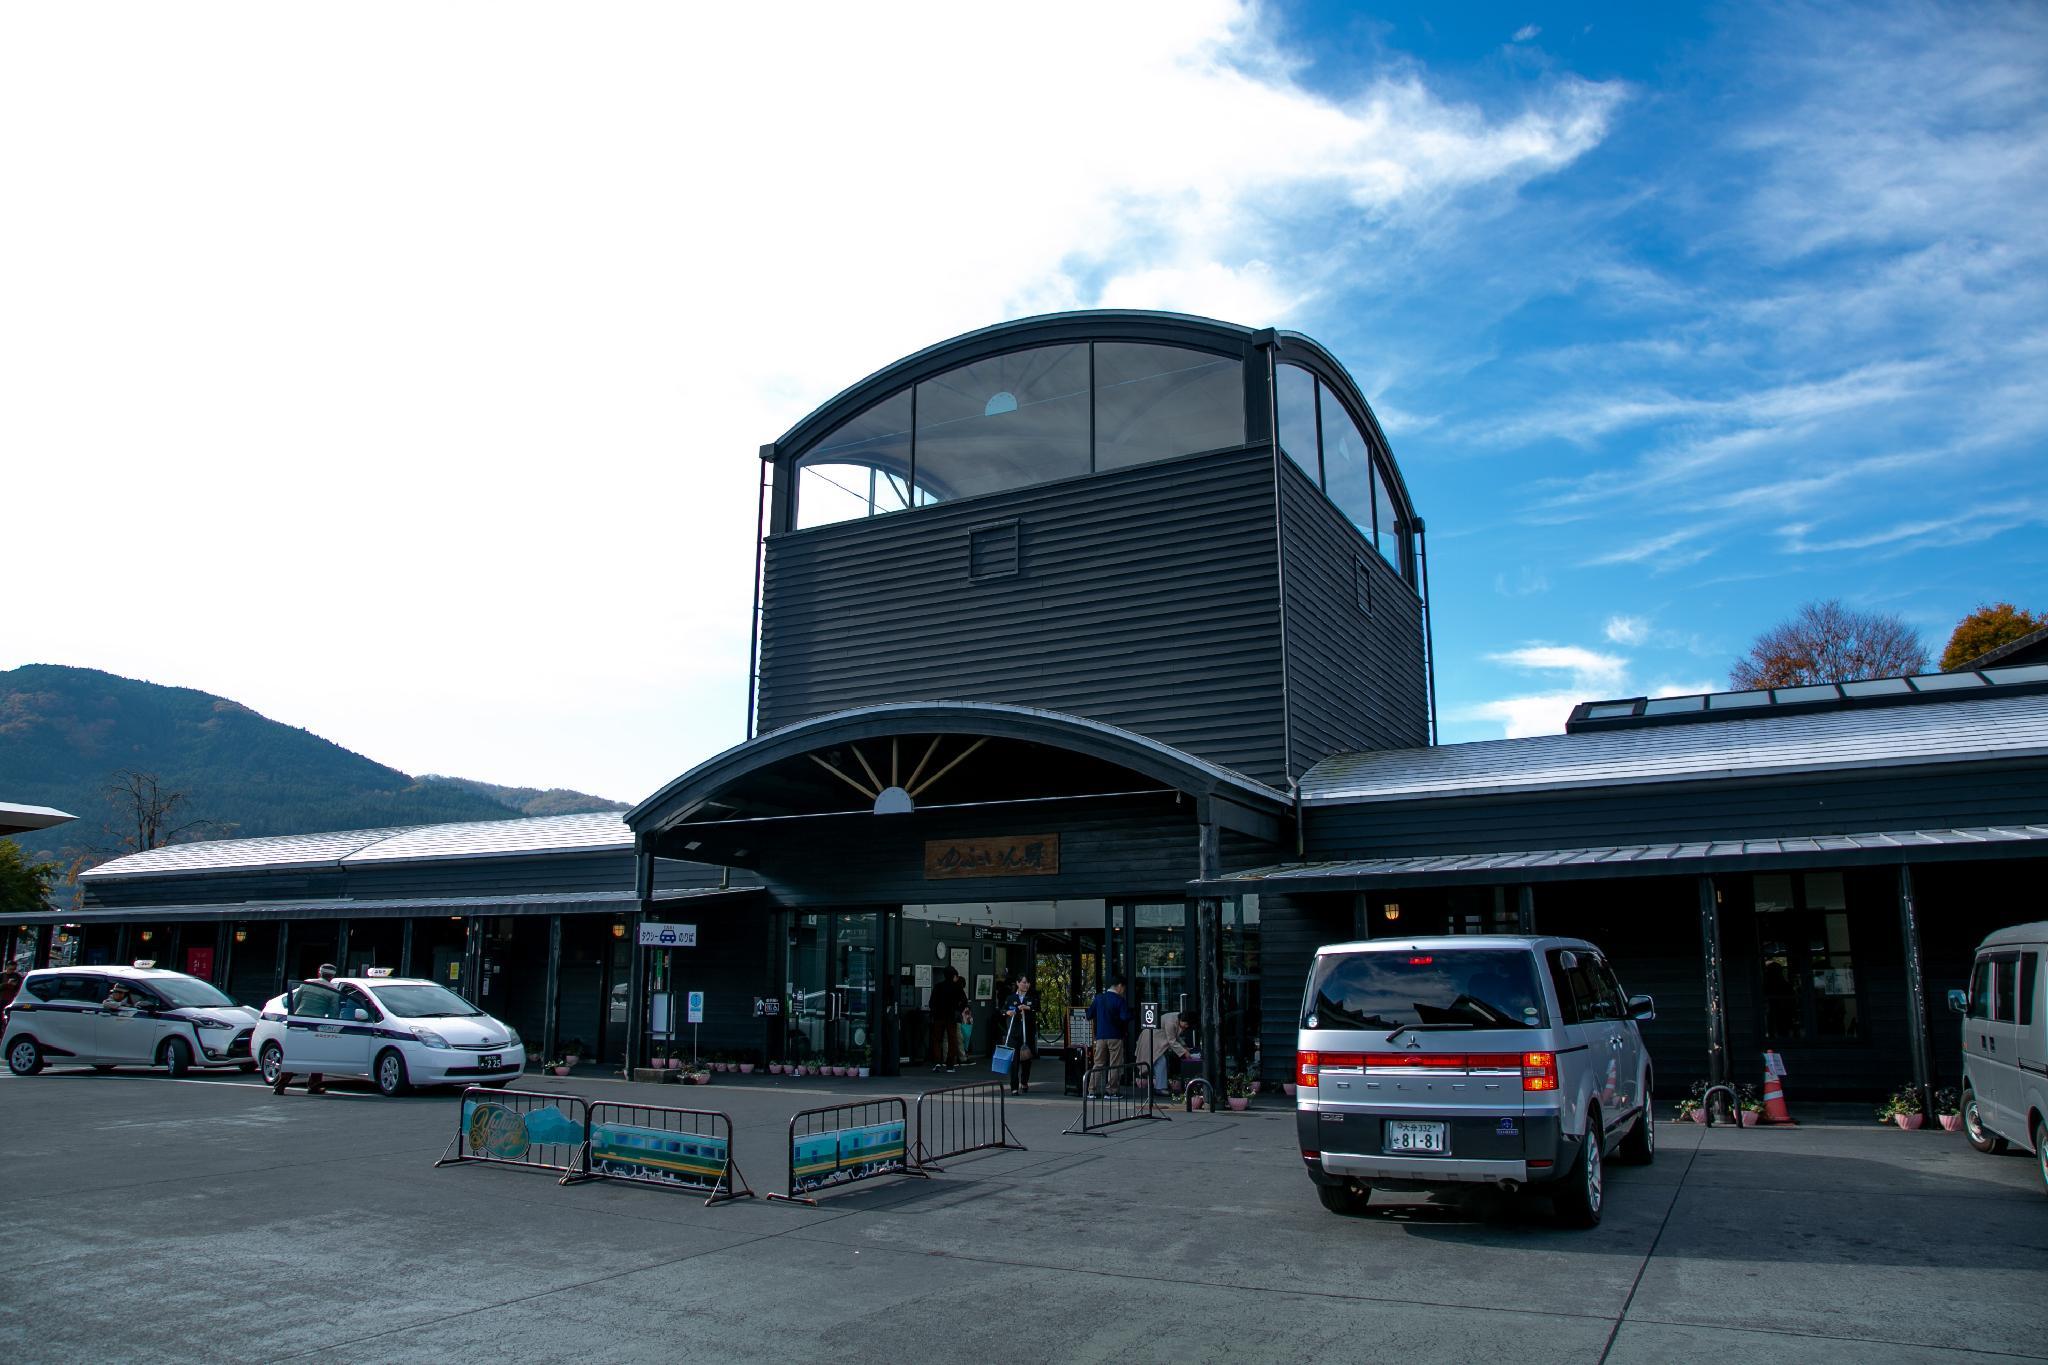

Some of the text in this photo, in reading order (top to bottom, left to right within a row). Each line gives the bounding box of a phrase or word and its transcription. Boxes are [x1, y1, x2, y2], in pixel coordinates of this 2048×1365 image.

[642, 931, 695, 943] タクシー のりば
[1402, 1133, 1439, 1149] 81-81
